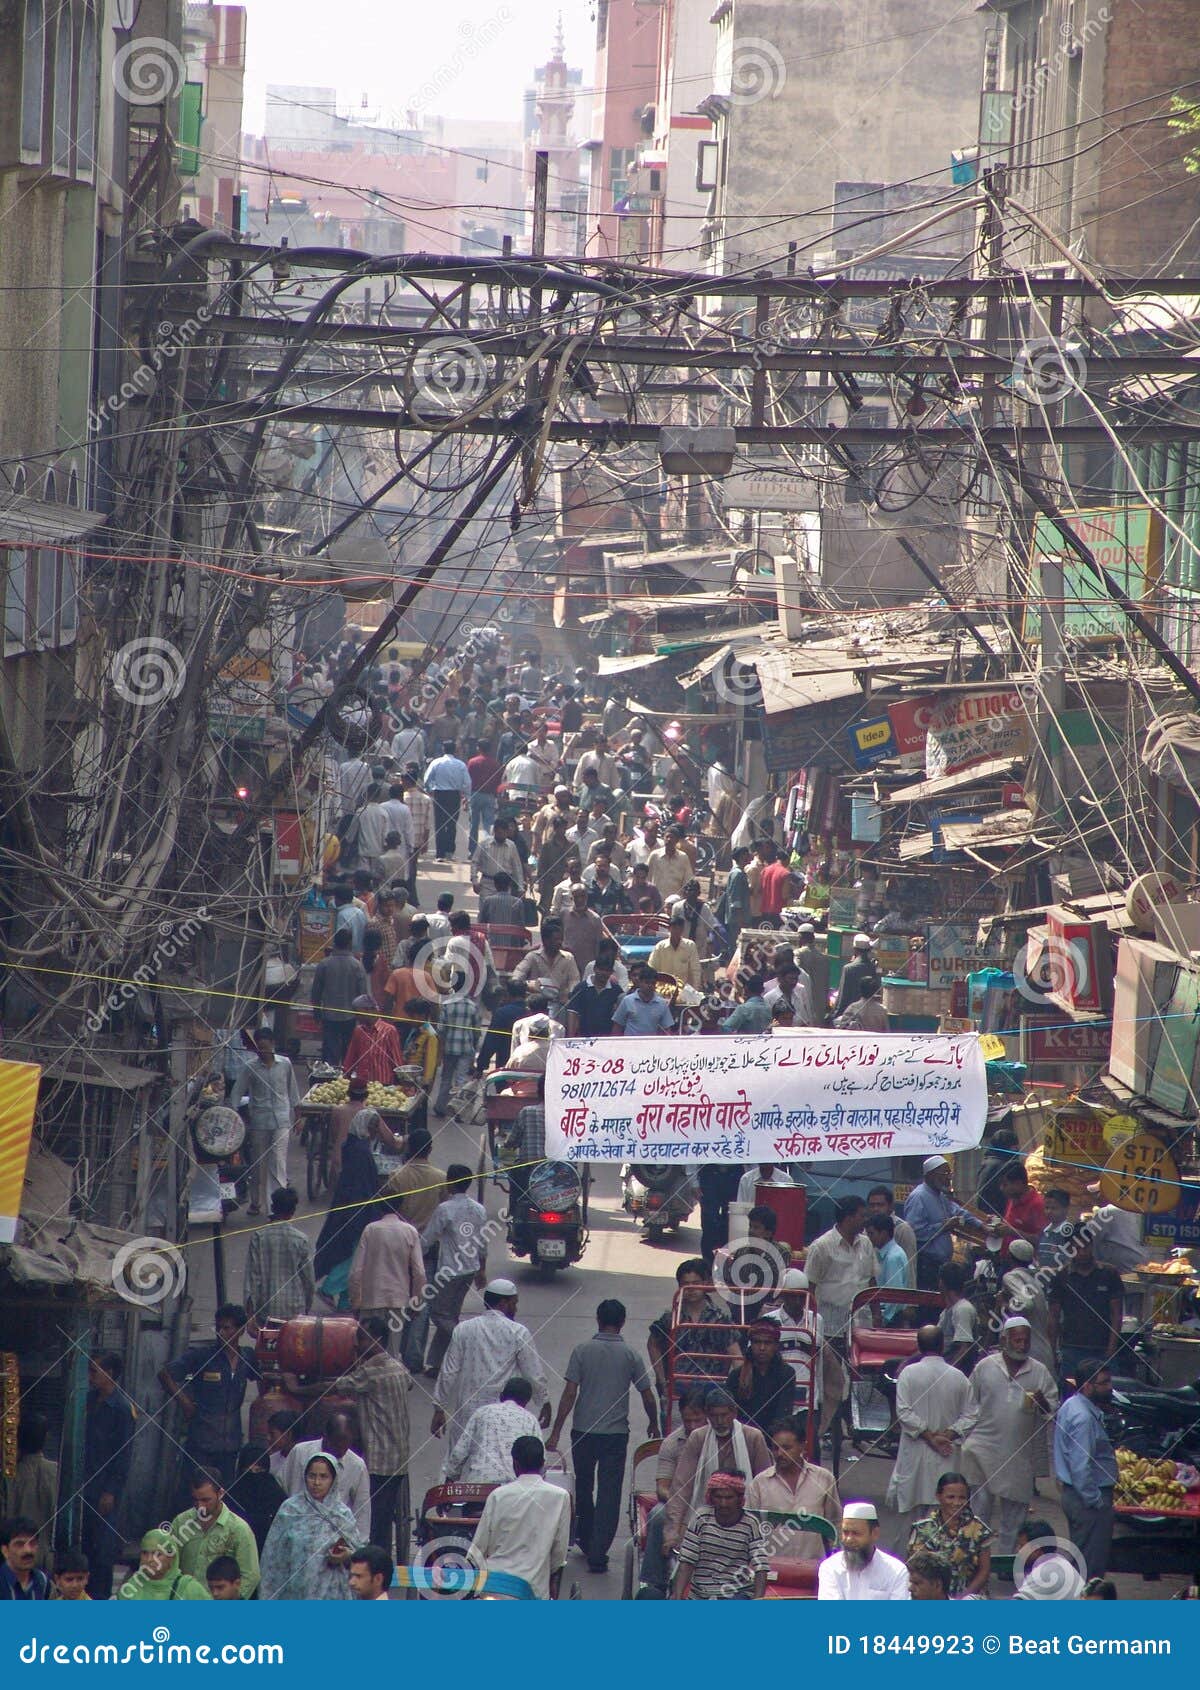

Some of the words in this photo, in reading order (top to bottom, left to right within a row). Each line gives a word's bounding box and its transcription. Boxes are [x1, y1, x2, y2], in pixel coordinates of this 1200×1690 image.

[562, 1057, 625, 1076] 28-3-08
[560, 1079, 637, 1099] 9810712674
[589, 1111, 599, 1134] के
[950, 1102, 962, 1126] में
[625, 1138, 637, 1158] में
[1125, 1143, 1164, 1163] STD
[1151, 1223, 1177, 1236] STD
